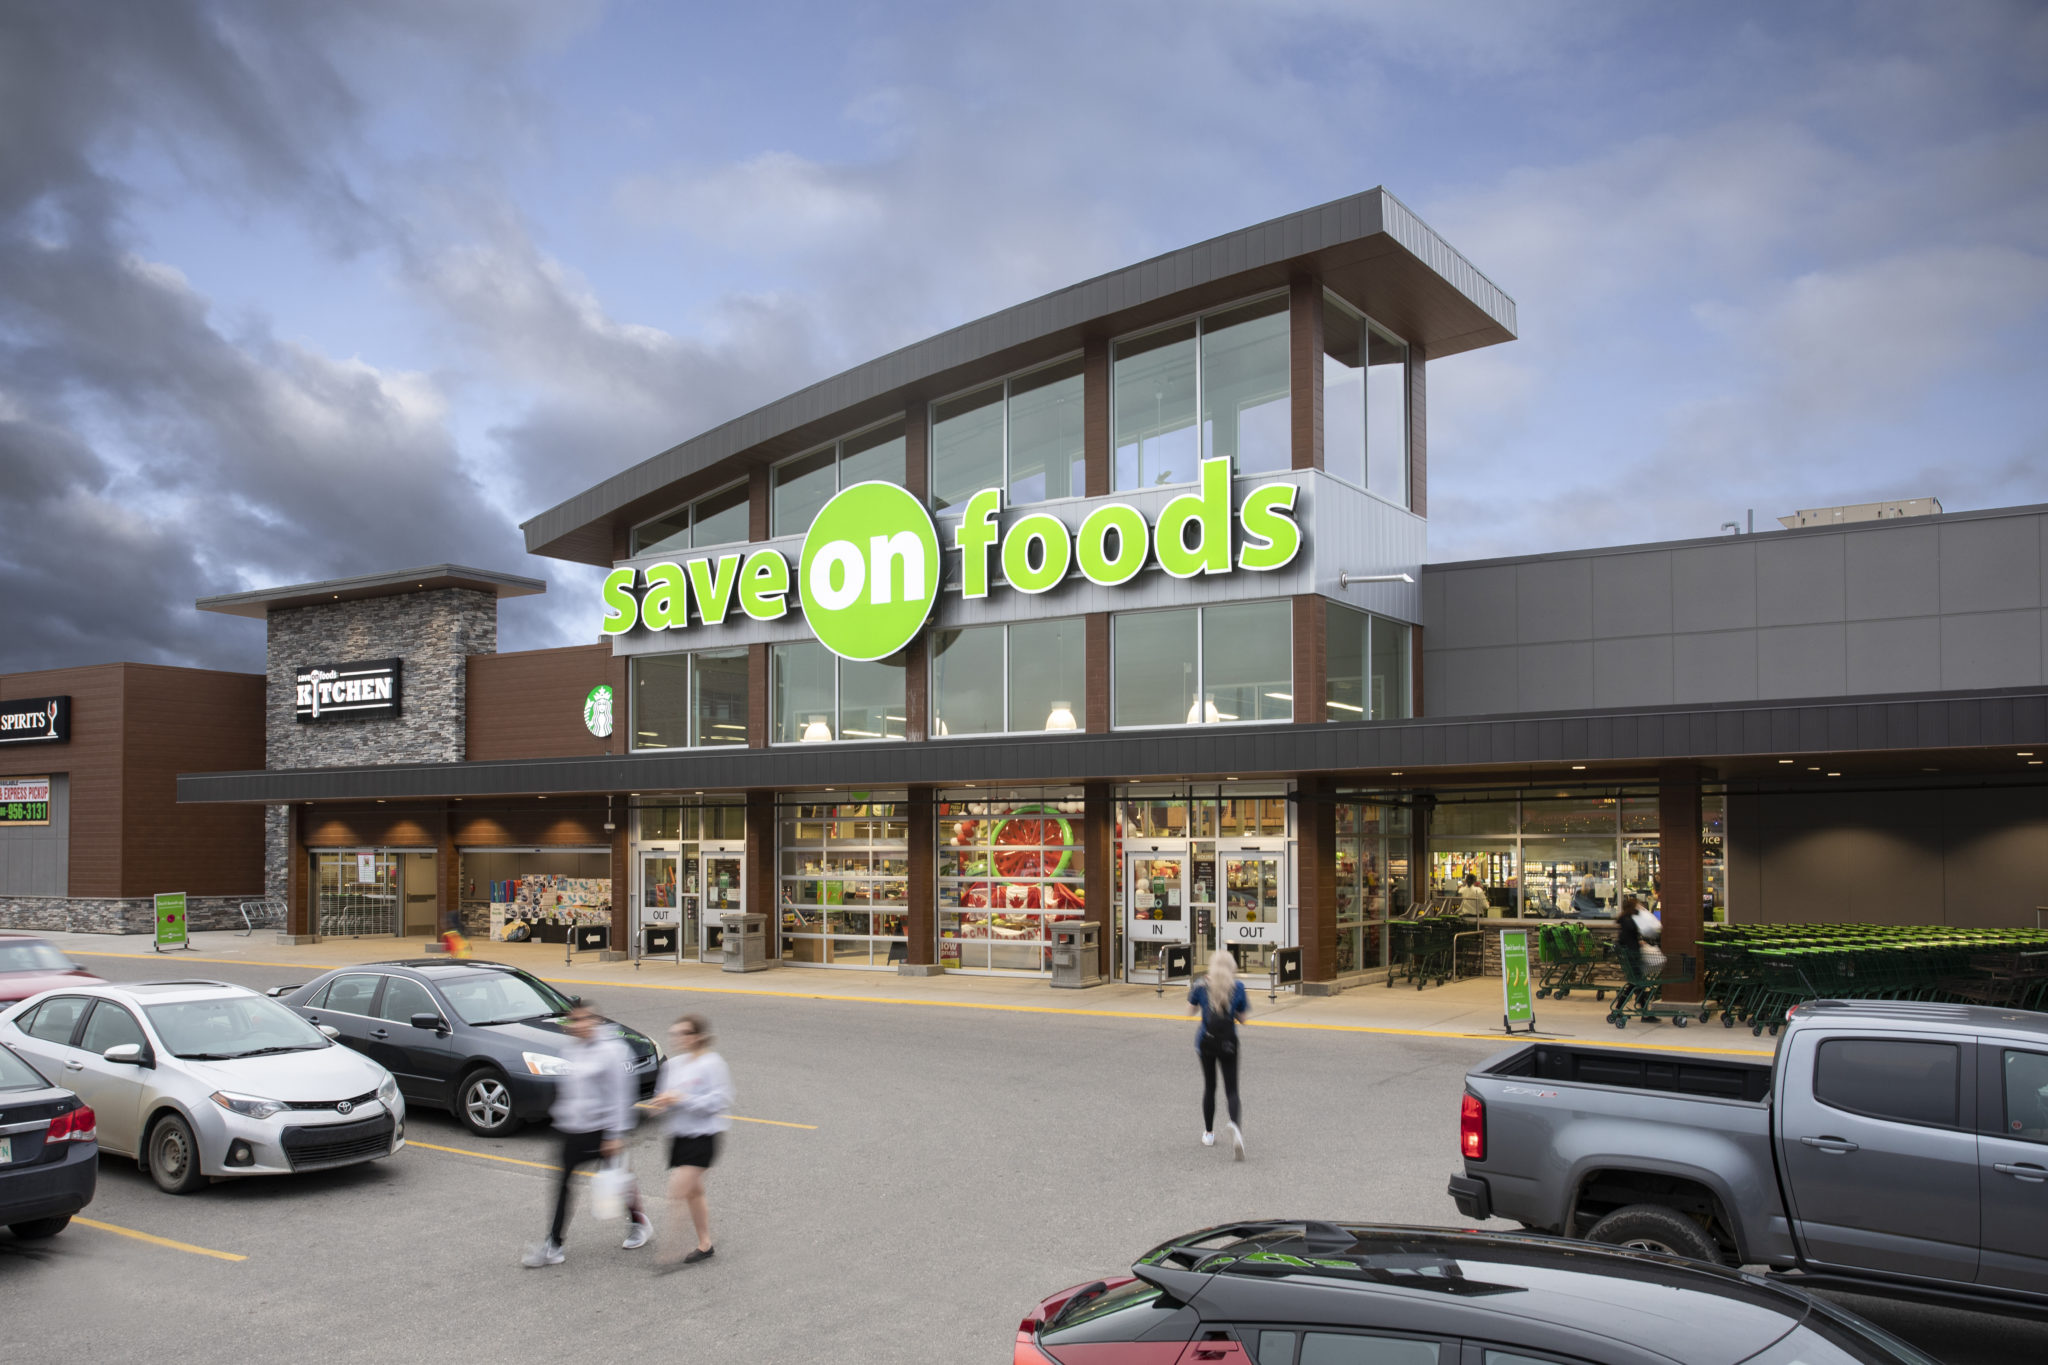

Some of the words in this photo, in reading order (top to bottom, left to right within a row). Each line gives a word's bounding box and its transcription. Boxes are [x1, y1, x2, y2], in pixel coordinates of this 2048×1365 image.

[602, 548, 790, 635] save
[809, 530, 926, 611] on
[954, 455, 1301, 599] foods
[296, 677, 393, 706] KITCHEN
[1, 711, 46, 731] SPIRITS
[4, 786, 28, 801] EXPRESS
[29, 785, 48, 800] PICKUP
[652, 910, 669, 920] OUT
[1152, 924, 1163, 935] IN
[1239, 926, 1264, 938] OUT
